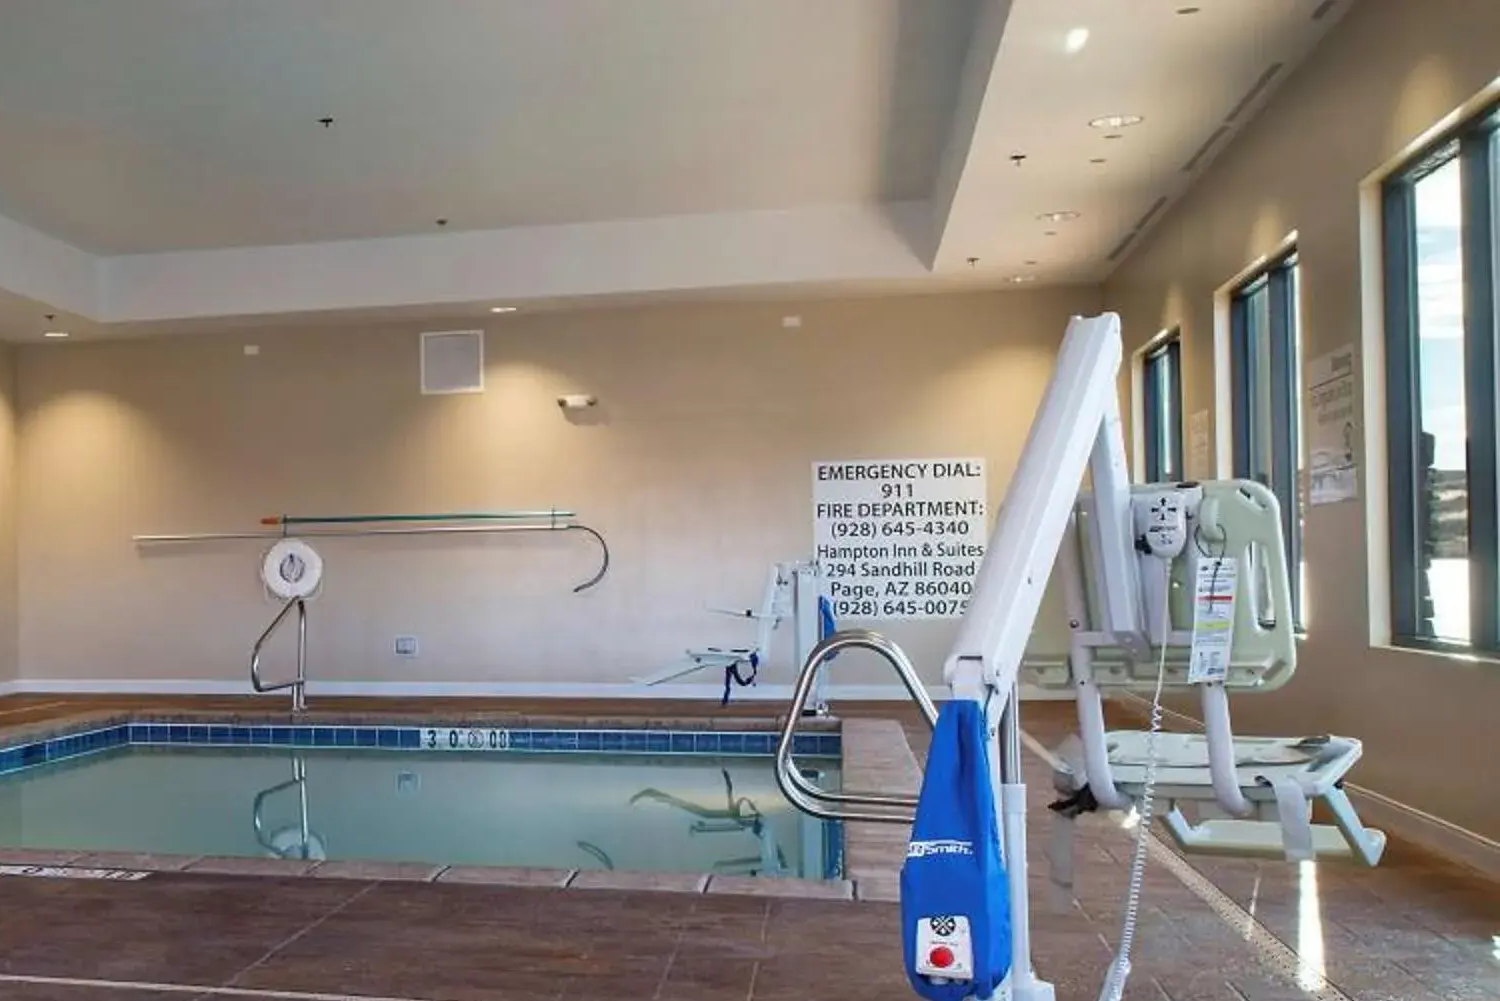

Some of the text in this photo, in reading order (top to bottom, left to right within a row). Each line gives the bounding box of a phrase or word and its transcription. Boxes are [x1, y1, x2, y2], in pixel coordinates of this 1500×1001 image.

[818, 463, 980, 481] EMERGENCY DIAL:
[881, 484, 913, 498] 911
[818, 502, 984, 518] FIRE DEPARTMENT:
[832, 521, 969, 538] (928) 645-4340
[818, 544, 984, 561] Hampton Inn & Suites
[827, 562, 975, 577] 294 Sandhill Road
[831, 582, 972, 598] Page, AZ 86040
[833, 602, 878, 617] (928)
[427, 730, 437, 748] 3
